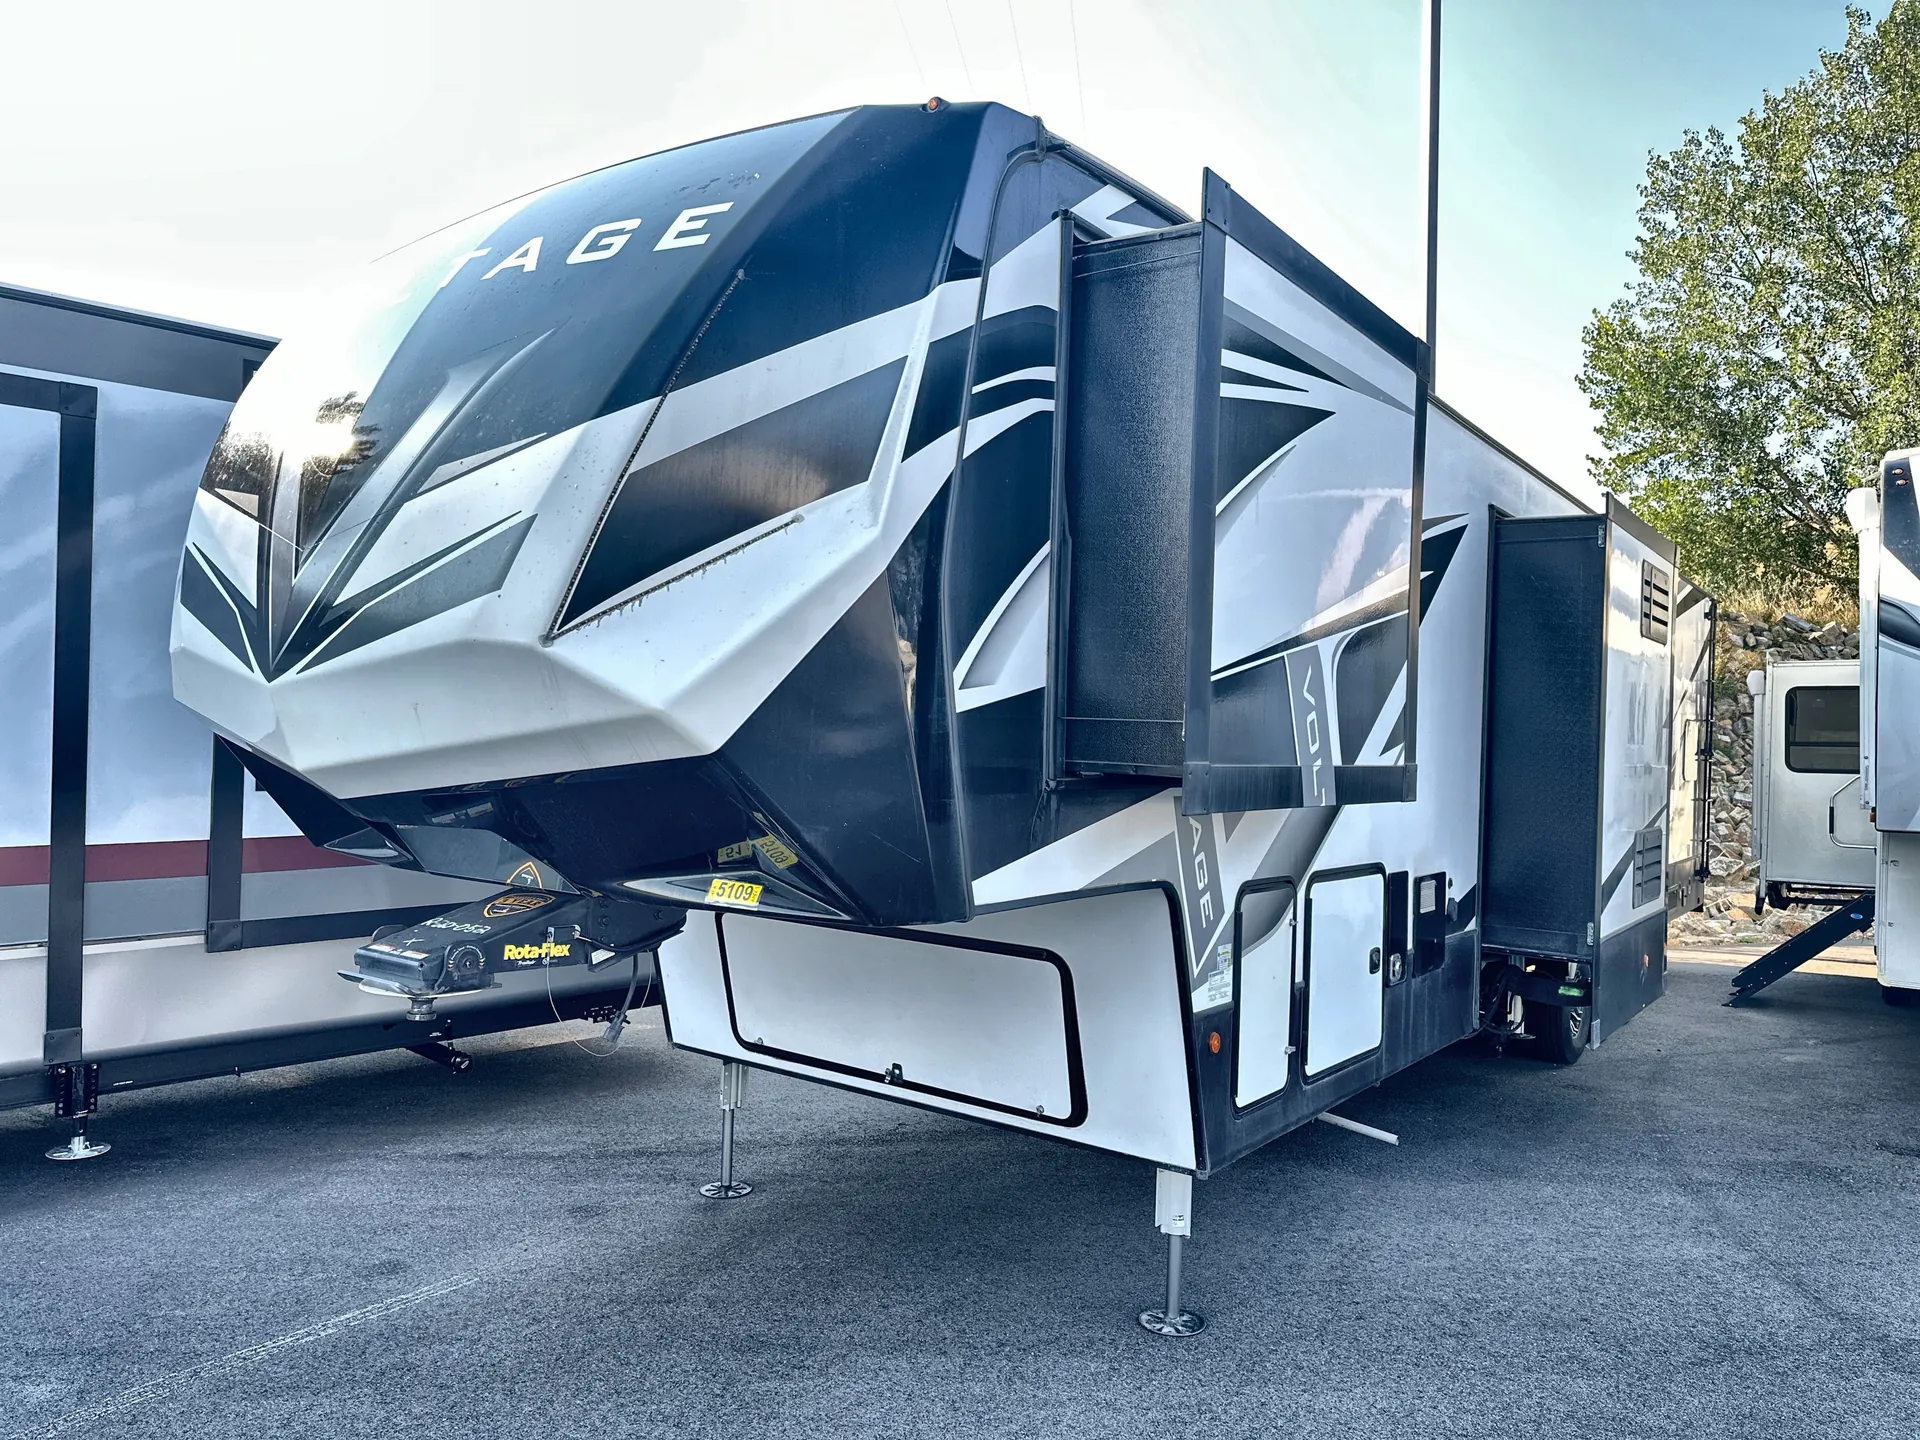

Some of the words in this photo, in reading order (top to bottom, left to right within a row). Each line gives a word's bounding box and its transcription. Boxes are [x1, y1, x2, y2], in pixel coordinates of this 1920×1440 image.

[1189, 816, 1214, 929] AGE
[716, 881, 755, 901] 5109
[503, 942, 572, 960] Rota-Flex
